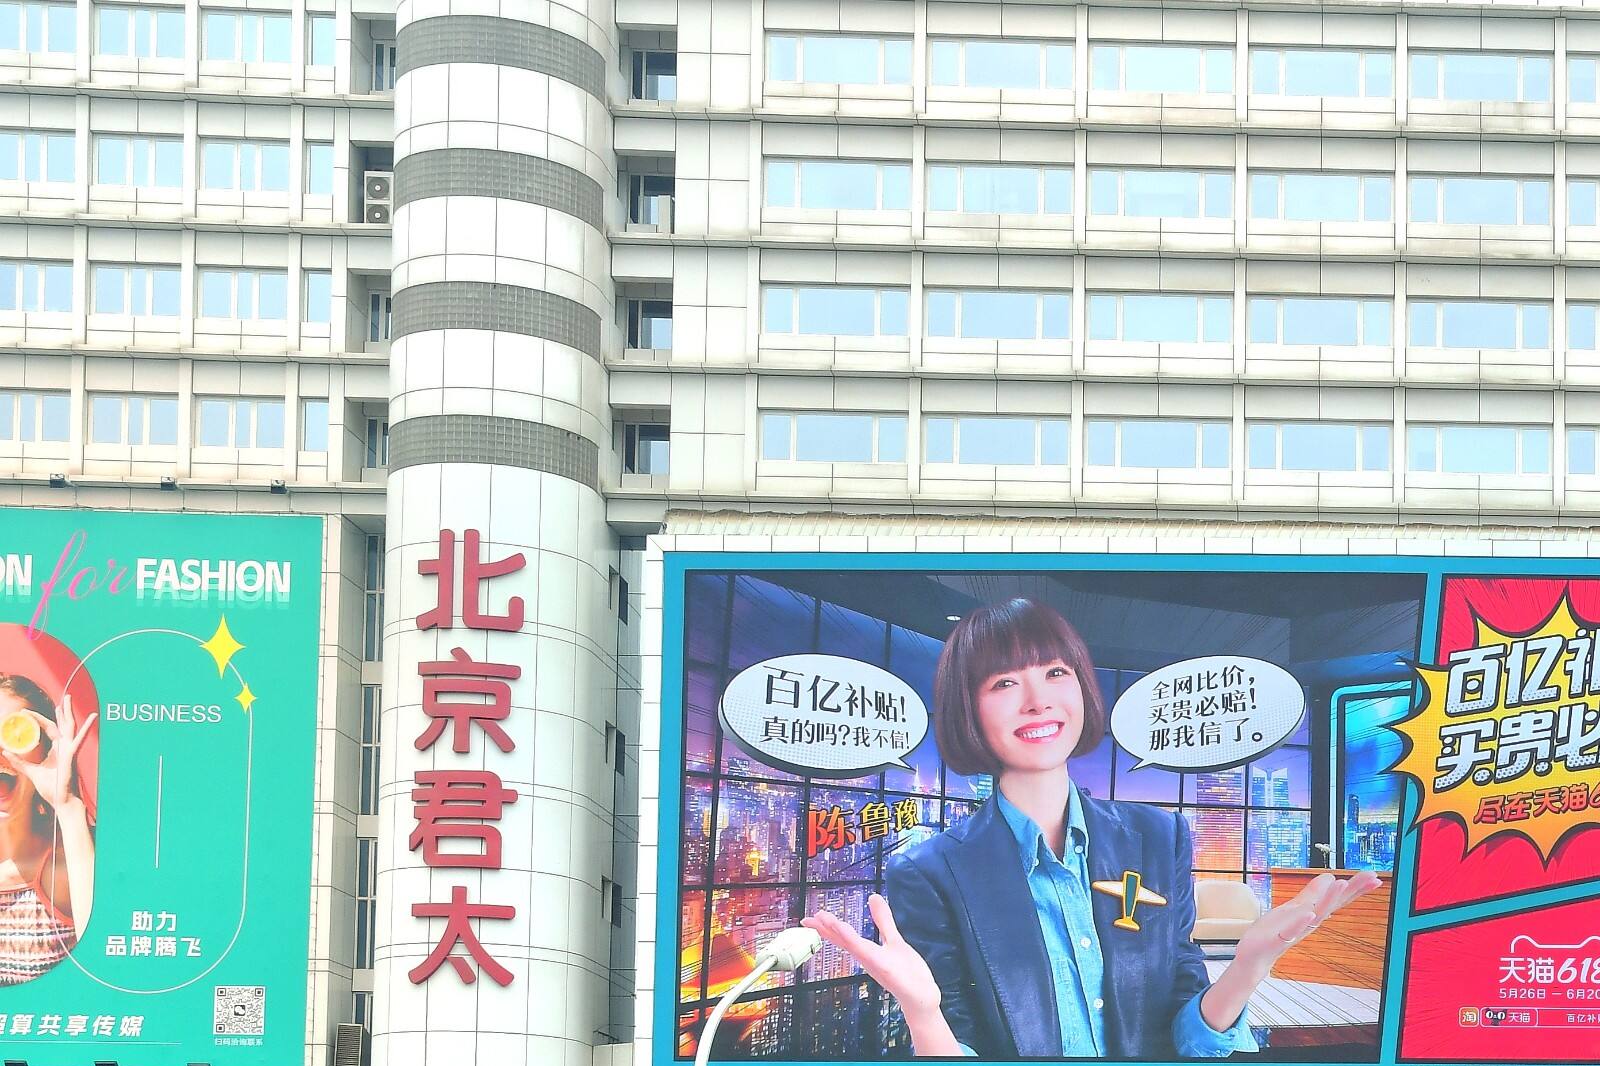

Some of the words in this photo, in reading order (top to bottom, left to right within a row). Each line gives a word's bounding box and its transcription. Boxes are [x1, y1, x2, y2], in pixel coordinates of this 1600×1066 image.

[0, 554, 32, 587] N
[27, 528, 136, 641] for
[136, 557, 291, 593] FASHION
[105, 702, 222, 724] BUSINESS
[409, 528, 527, 987] 北京君太
[807, 798, 920, 859] 陈鲁豫
[131, 911, 177, 932] 助力
[105, 936, 202, 957] 品牌腾飞
[1499, 988, 1546, 999] 5月26日
[1508, 1012, 1531, 1023] 天猫
